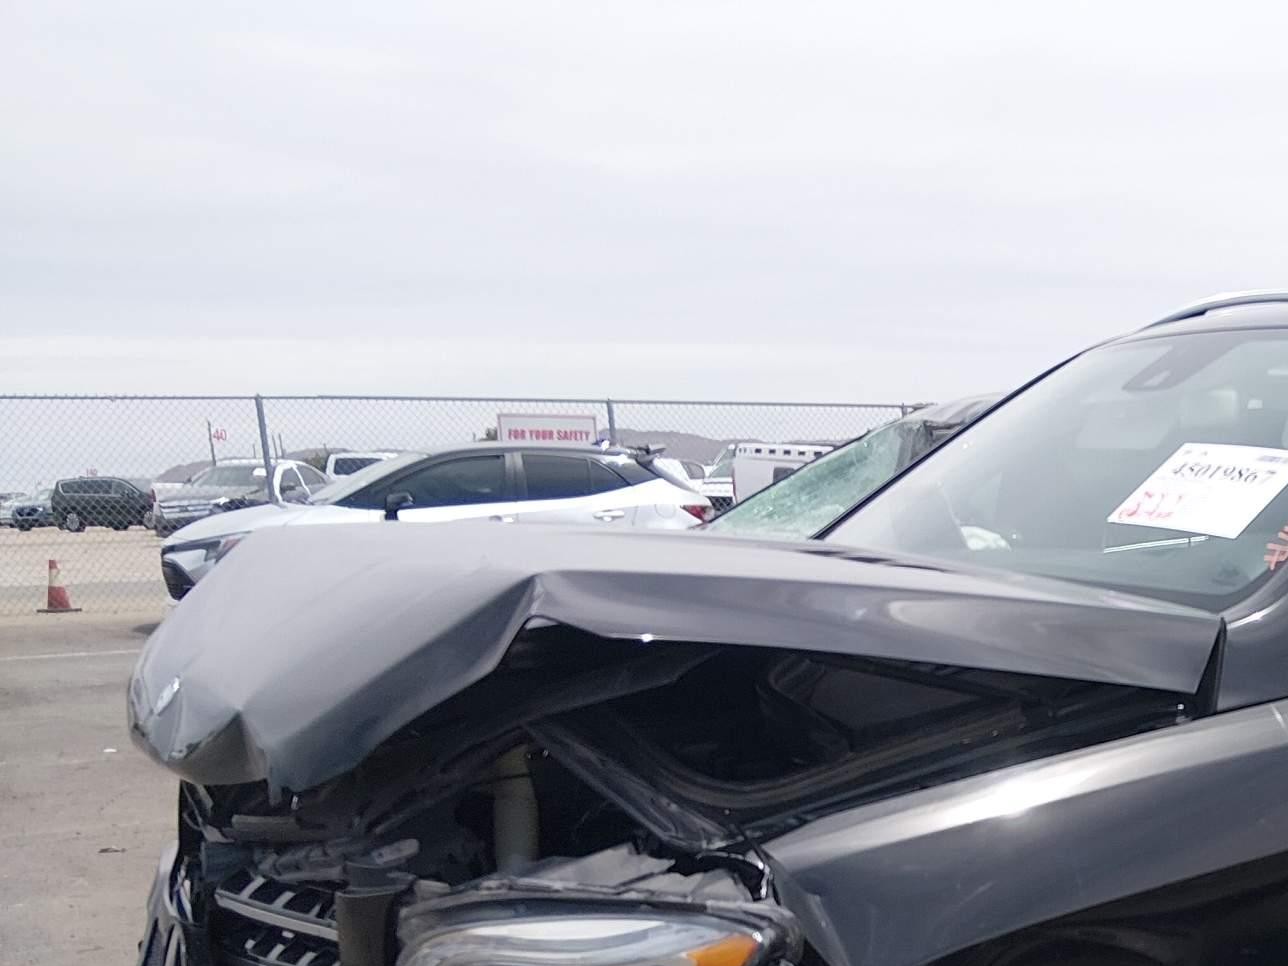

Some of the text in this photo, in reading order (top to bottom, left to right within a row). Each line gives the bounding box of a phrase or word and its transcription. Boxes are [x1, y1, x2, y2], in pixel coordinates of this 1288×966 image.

[508, 428, 590, 441] FOR YOUR SAFETY
[1172, 461, 1277, 485] 45019867
